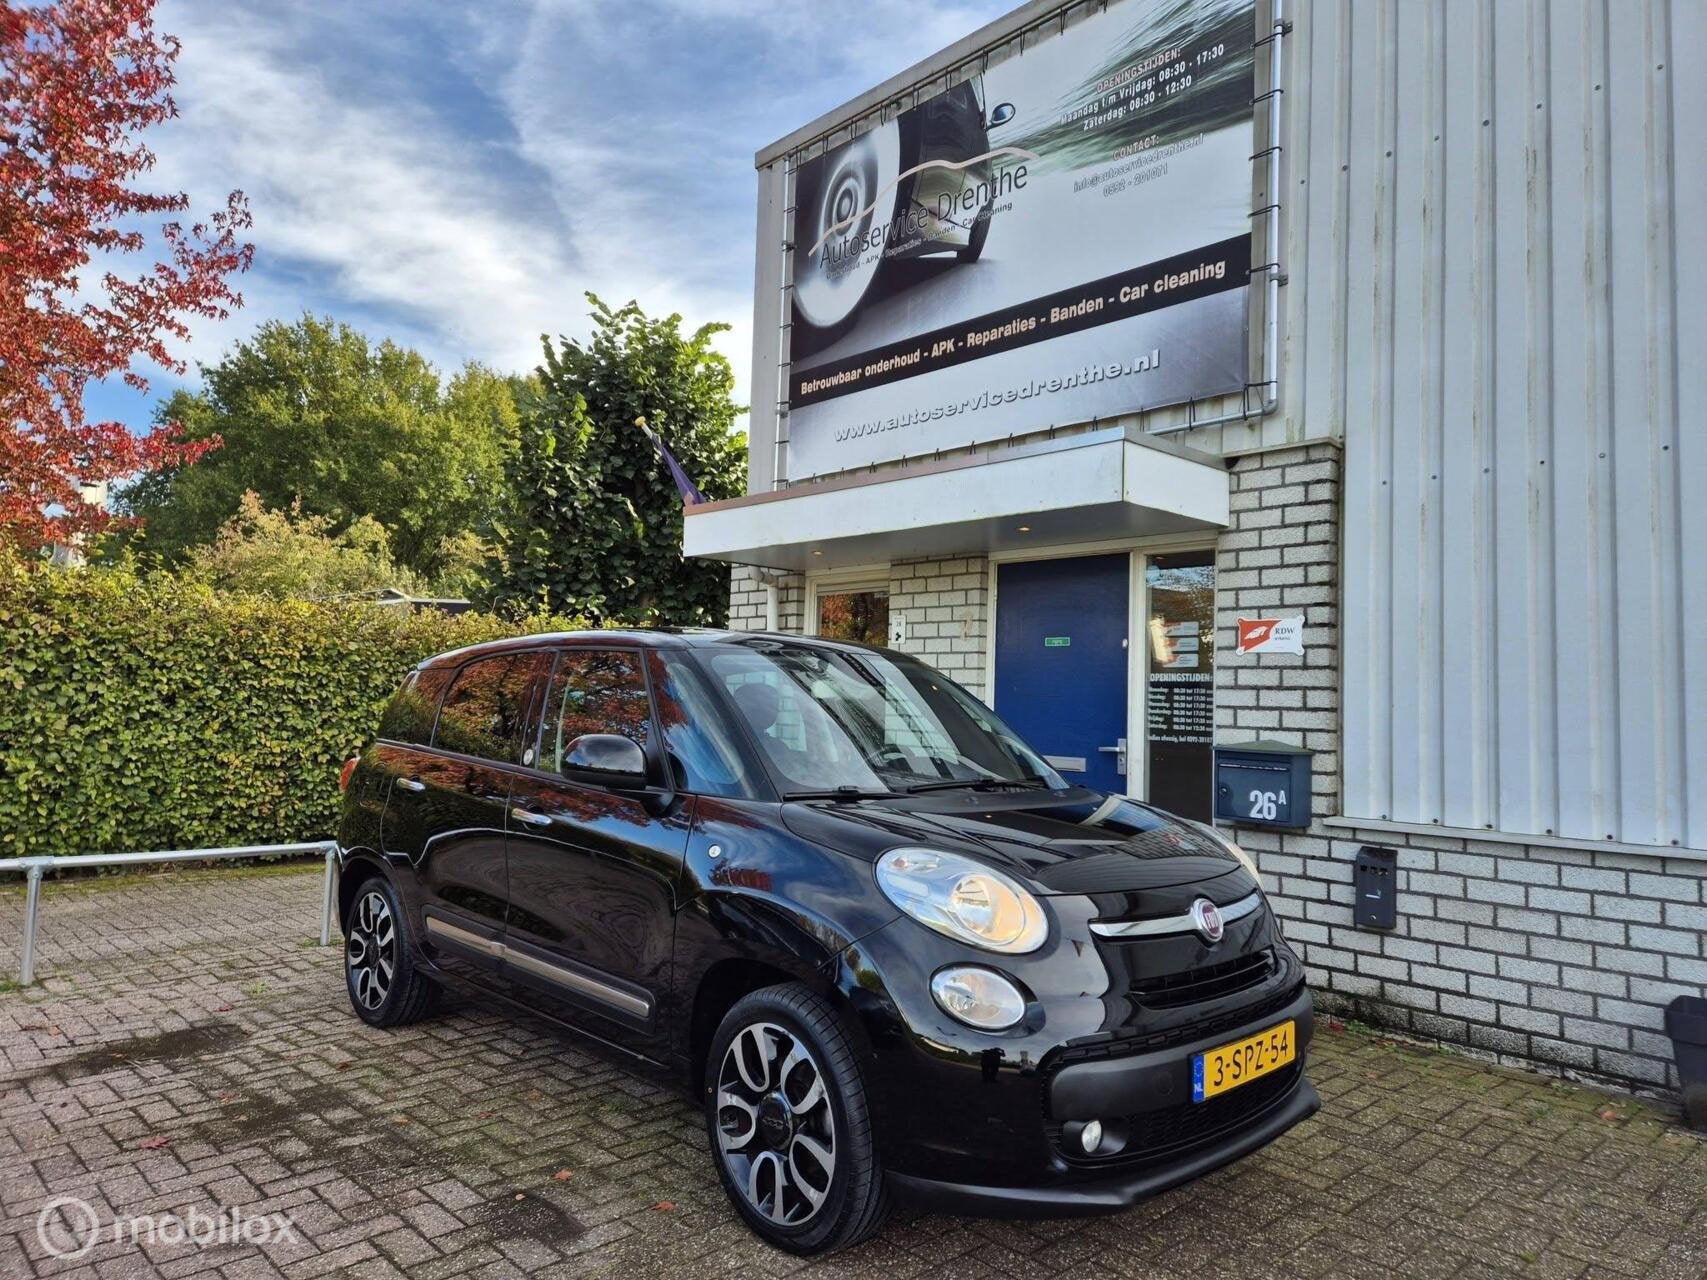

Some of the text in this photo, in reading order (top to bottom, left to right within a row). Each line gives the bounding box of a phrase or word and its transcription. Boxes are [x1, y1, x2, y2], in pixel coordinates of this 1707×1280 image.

[1061, 101, 1099, 124] Maandag
[1119, 76, 1156, 100] Vrijdag:
[1159, 61, 1186, 81] 08:30
[1196, 43, 1224, 66] 17:30
[1097, 48, 1181, 93] OPENINGSTIJDEN:
[1083, 104, 1127, 131] Zaterdag:
[1129, 91, 1155, 111] 08:30
[1165, 75, 1192, 95] 12:30
[1112, 134, 1160, 161] CONTACT:
[820, 165, 1028, 268] Autoservice Drenthe
[801, 368, 862, 395] Betrouwbaar
[865, 349, 920, 378] onderhoud
[931, 338, 955, 360] APK
[967, 316, 1036, 348] Reparaties
[1050, 296, 1104, 324] Banden
[1119, 283, 1149, 304] Car
[1153, 260, 1226, 294] cleaning
[833, 348, 1161, 442] www.autoservicedrenthe.nl
[1274, 627, 1295, 635] RDW
[1213, 1029, 1288, 1087] 3-SPZ-54
